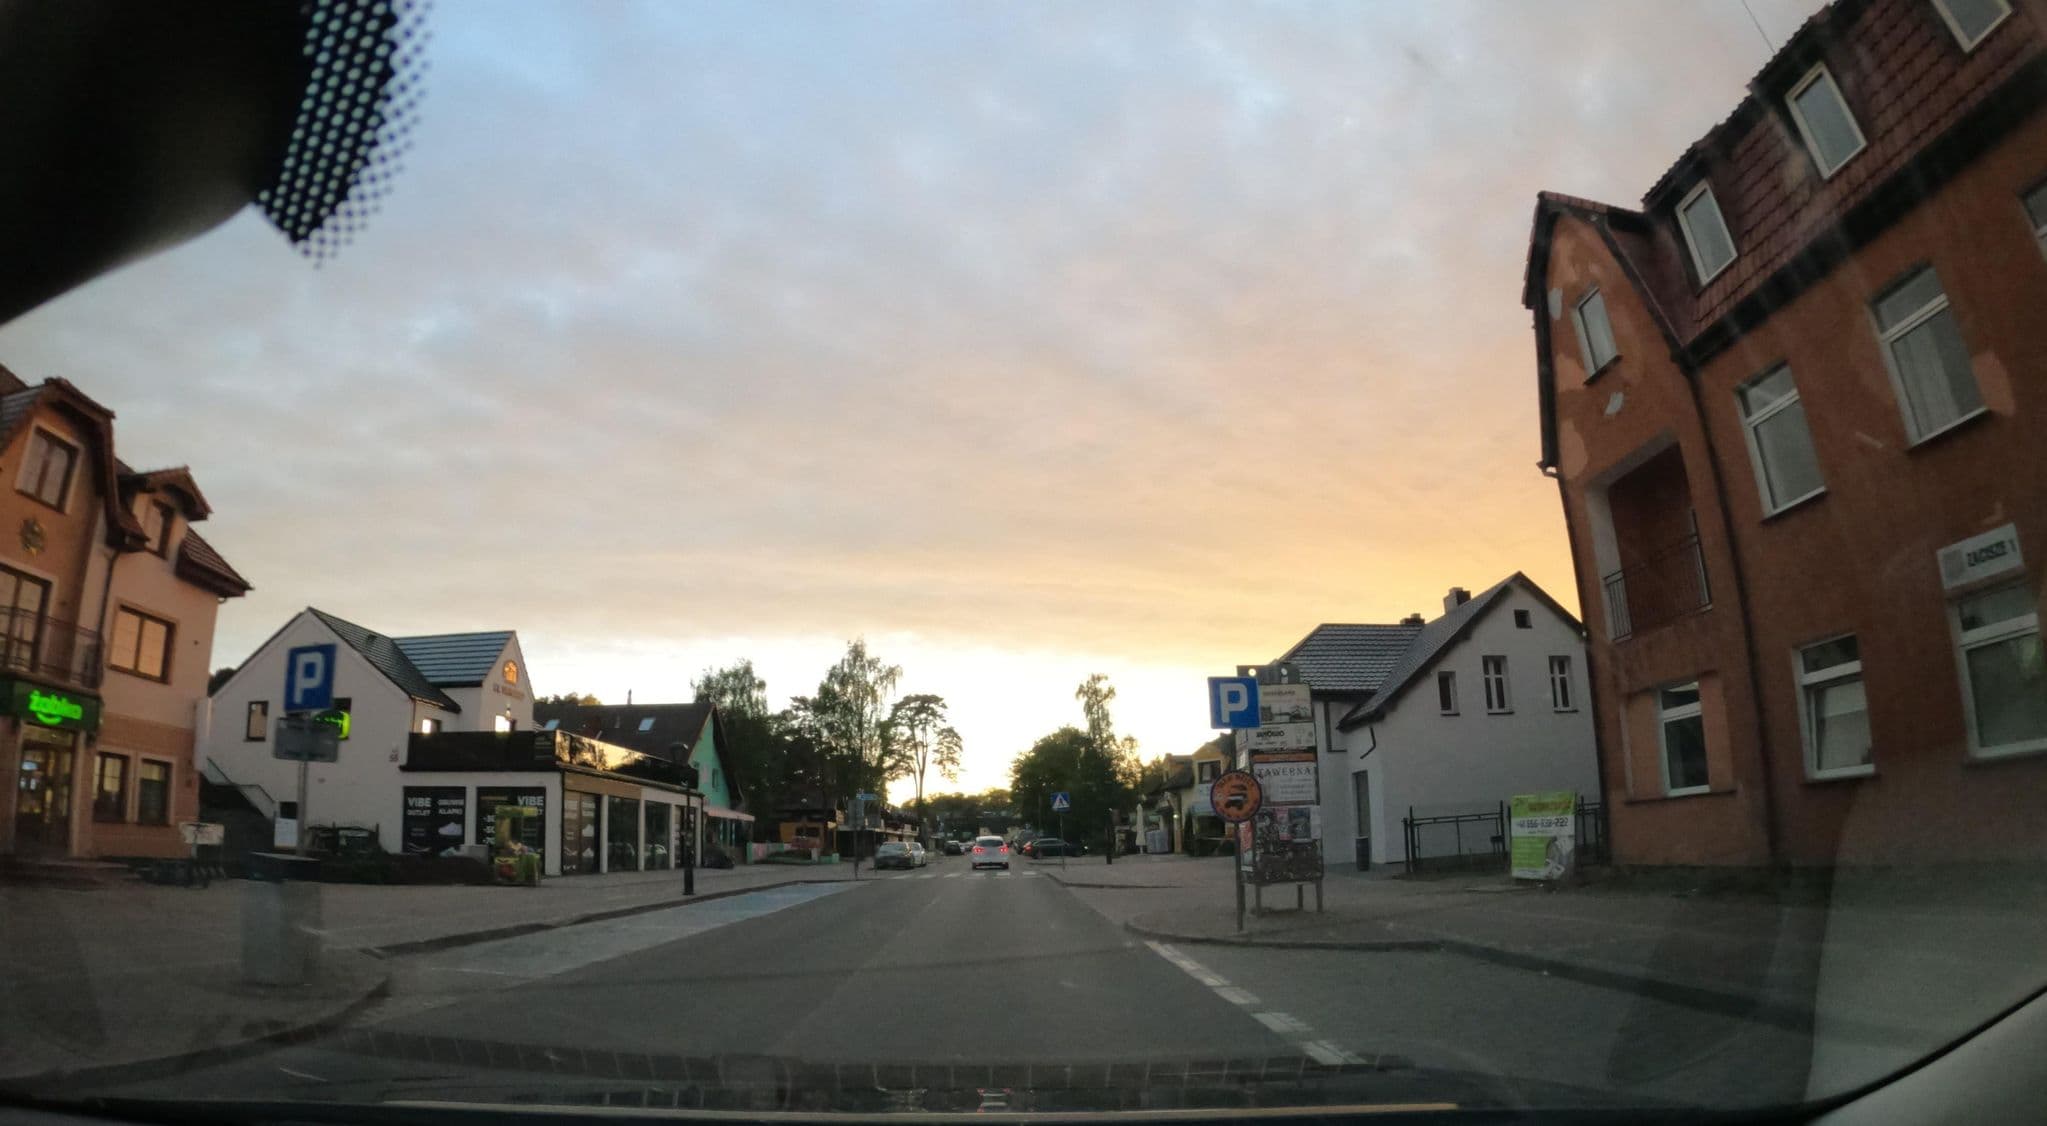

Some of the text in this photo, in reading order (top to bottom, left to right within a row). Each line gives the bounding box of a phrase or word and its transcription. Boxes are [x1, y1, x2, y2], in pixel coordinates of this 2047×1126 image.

[294, 652, 325, 705] P
[1219, 683, 1249, 724] P
[1257, 767, 1312, 778] TAWERNA
[407, 797, 432, 807] VIBE
[517, 795, 544, 806] VIBE
